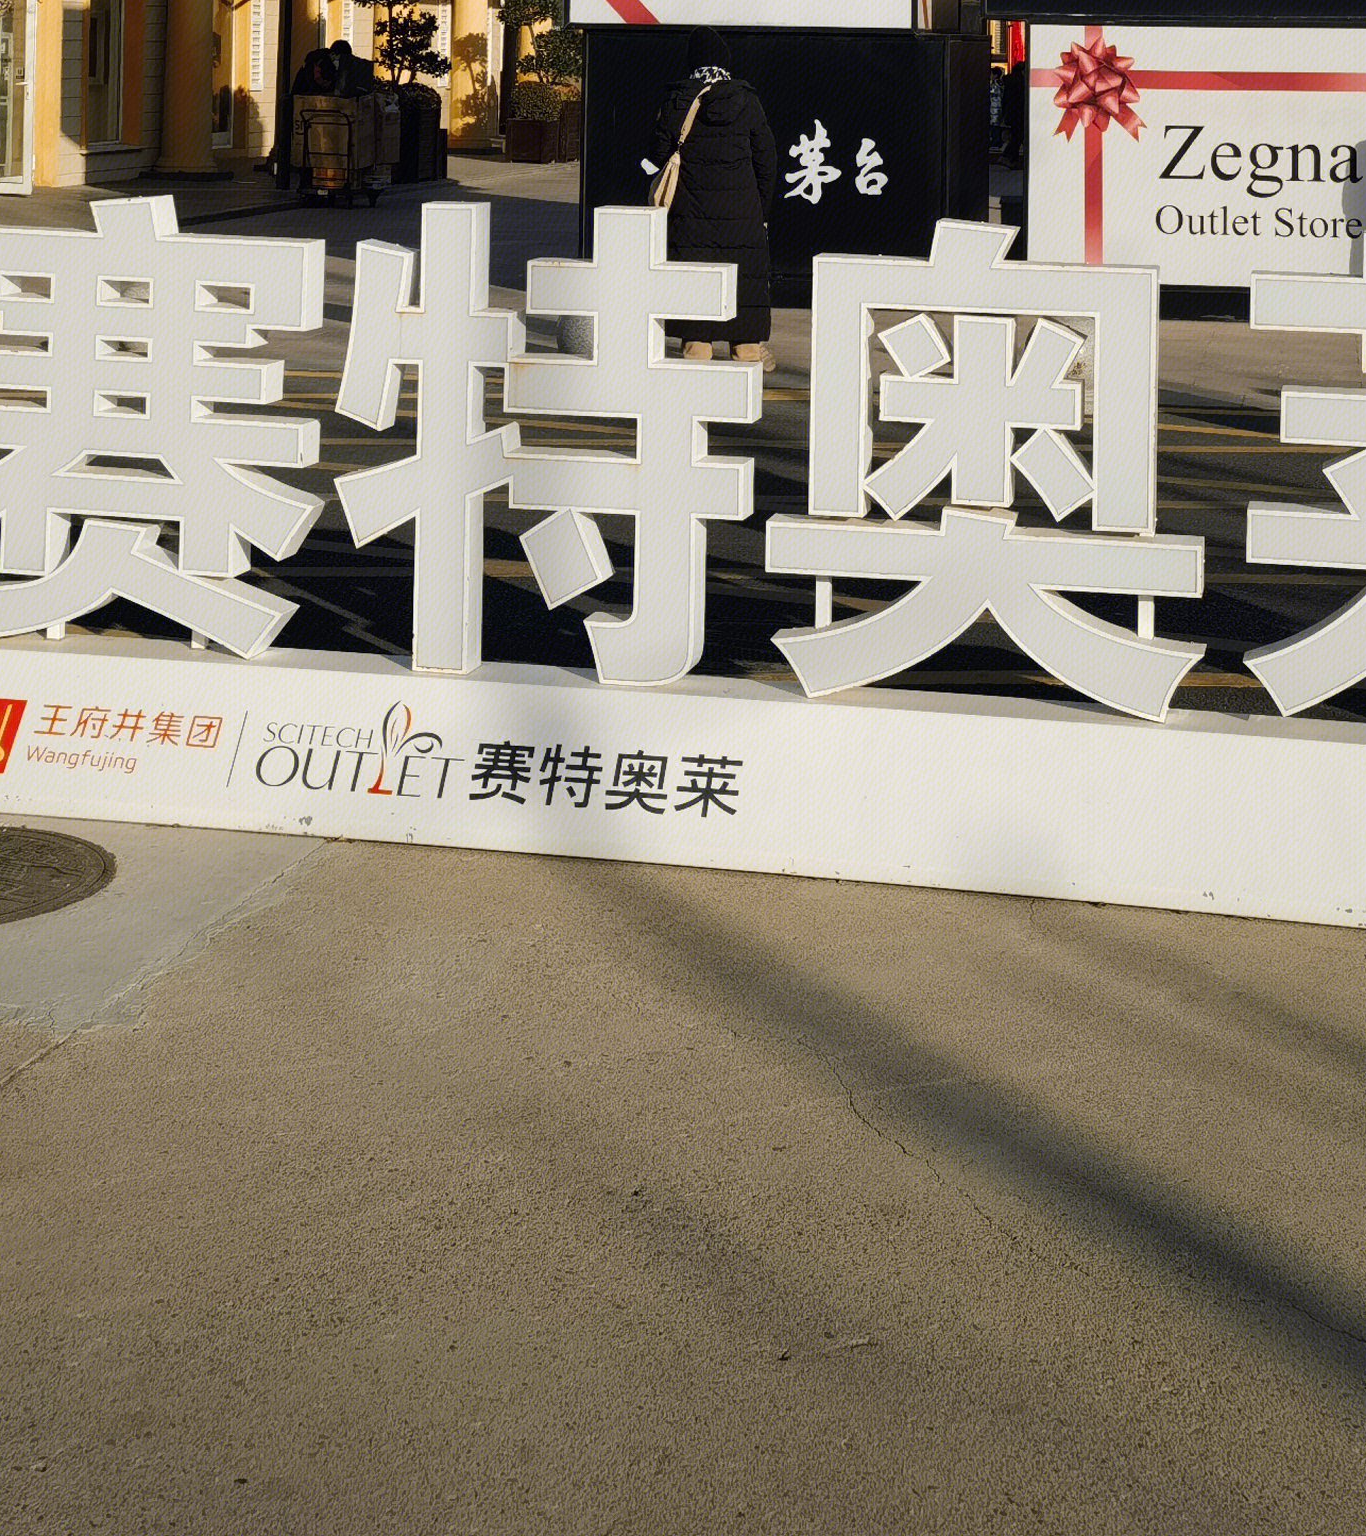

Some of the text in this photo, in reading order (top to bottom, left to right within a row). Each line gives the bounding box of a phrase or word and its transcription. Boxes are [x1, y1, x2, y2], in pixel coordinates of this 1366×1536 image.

[1158, 124, 1364, 198] Zegna
[1155, 204, 1363, 240] Outlet Store
[33, 703, 223, 749] 王府井集团
[262, 721, 374, 749] SCITECH
[26, 744, 138, 775] Wangfujing
[255, 736, 466, 799] OUTLET
[468, 740, 744, 818] 赛特奥莱
